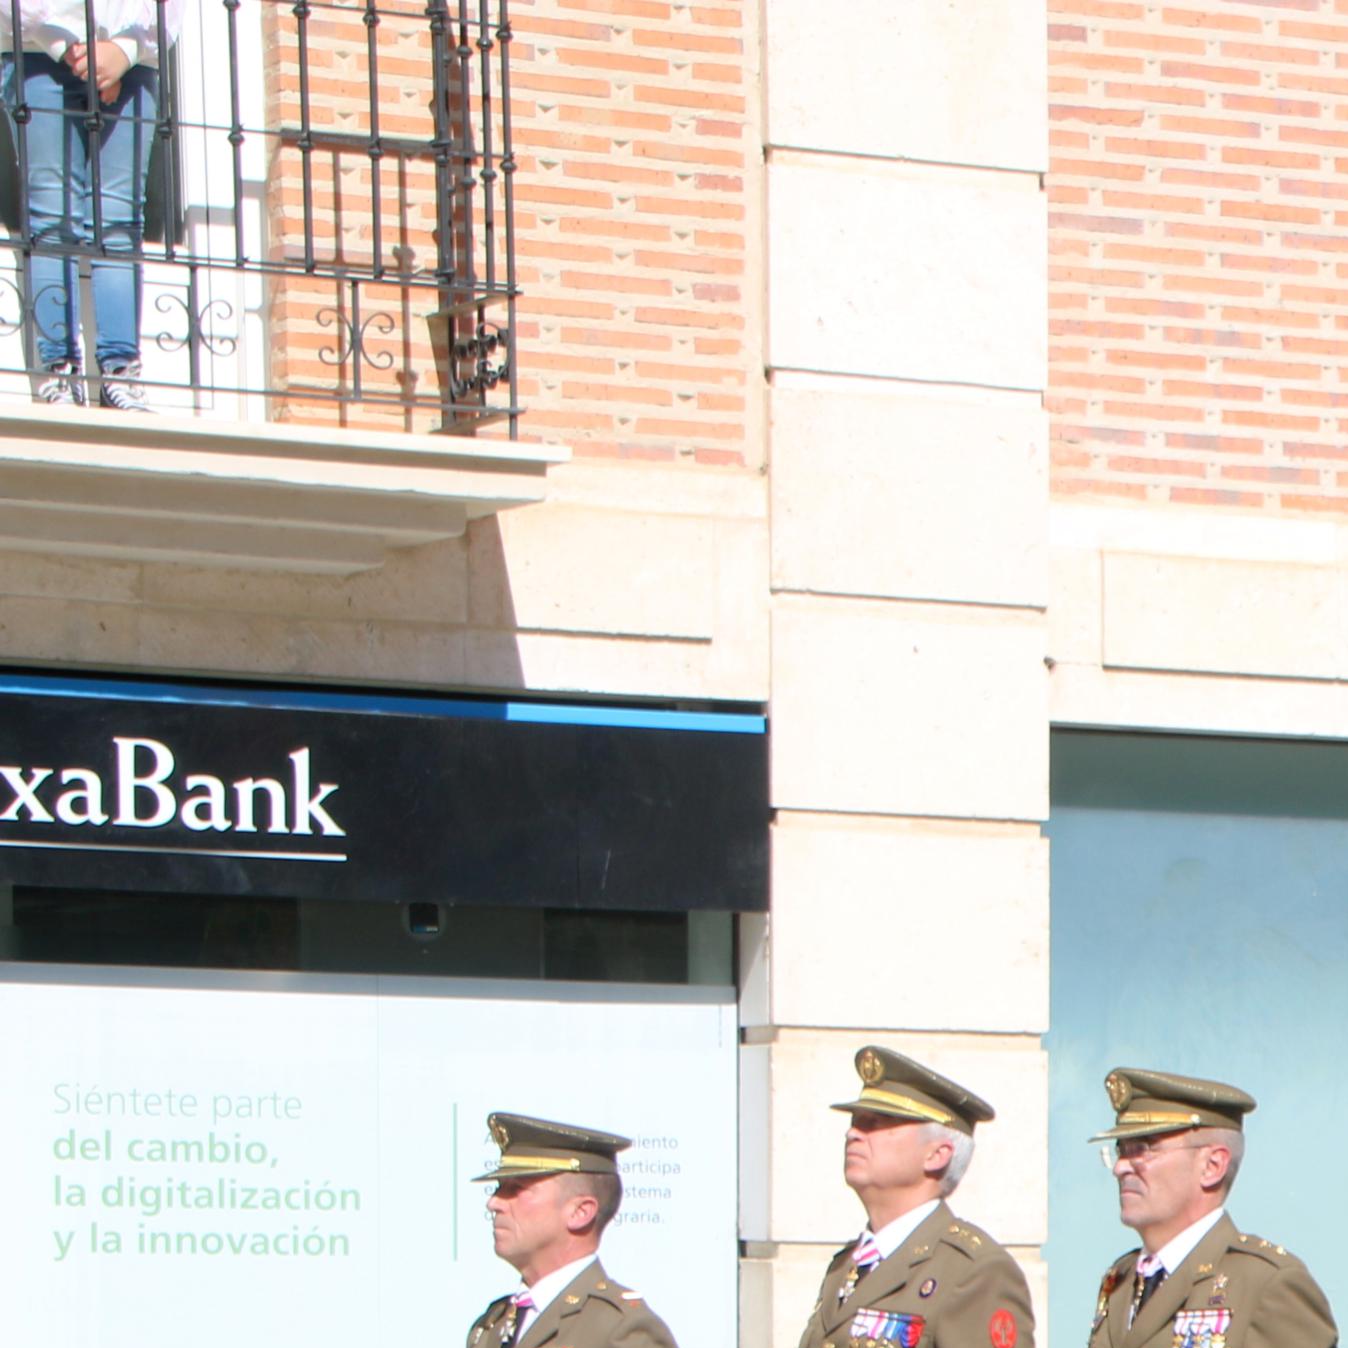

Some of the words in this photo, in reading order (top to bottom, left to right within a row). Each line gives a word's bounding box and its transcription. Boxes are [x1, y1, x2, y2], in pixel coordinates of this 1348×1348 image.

[0, 736, 347, 837] xaBank
[53, 1083, 198, 1118] Siéntete
[212, 1090, 302, 1126] parte
[53, 1128, 112, 1161] del
[127, 1132, 278, 1169] cambio,
[55, 1175, 86, 1207] la
[101, 1176, 361, 1217] digitalización
[52, 1230, 76, 1262] y
[91, 1222, 122, 1254] la
[138, 1223, 350, 1256] innovación
